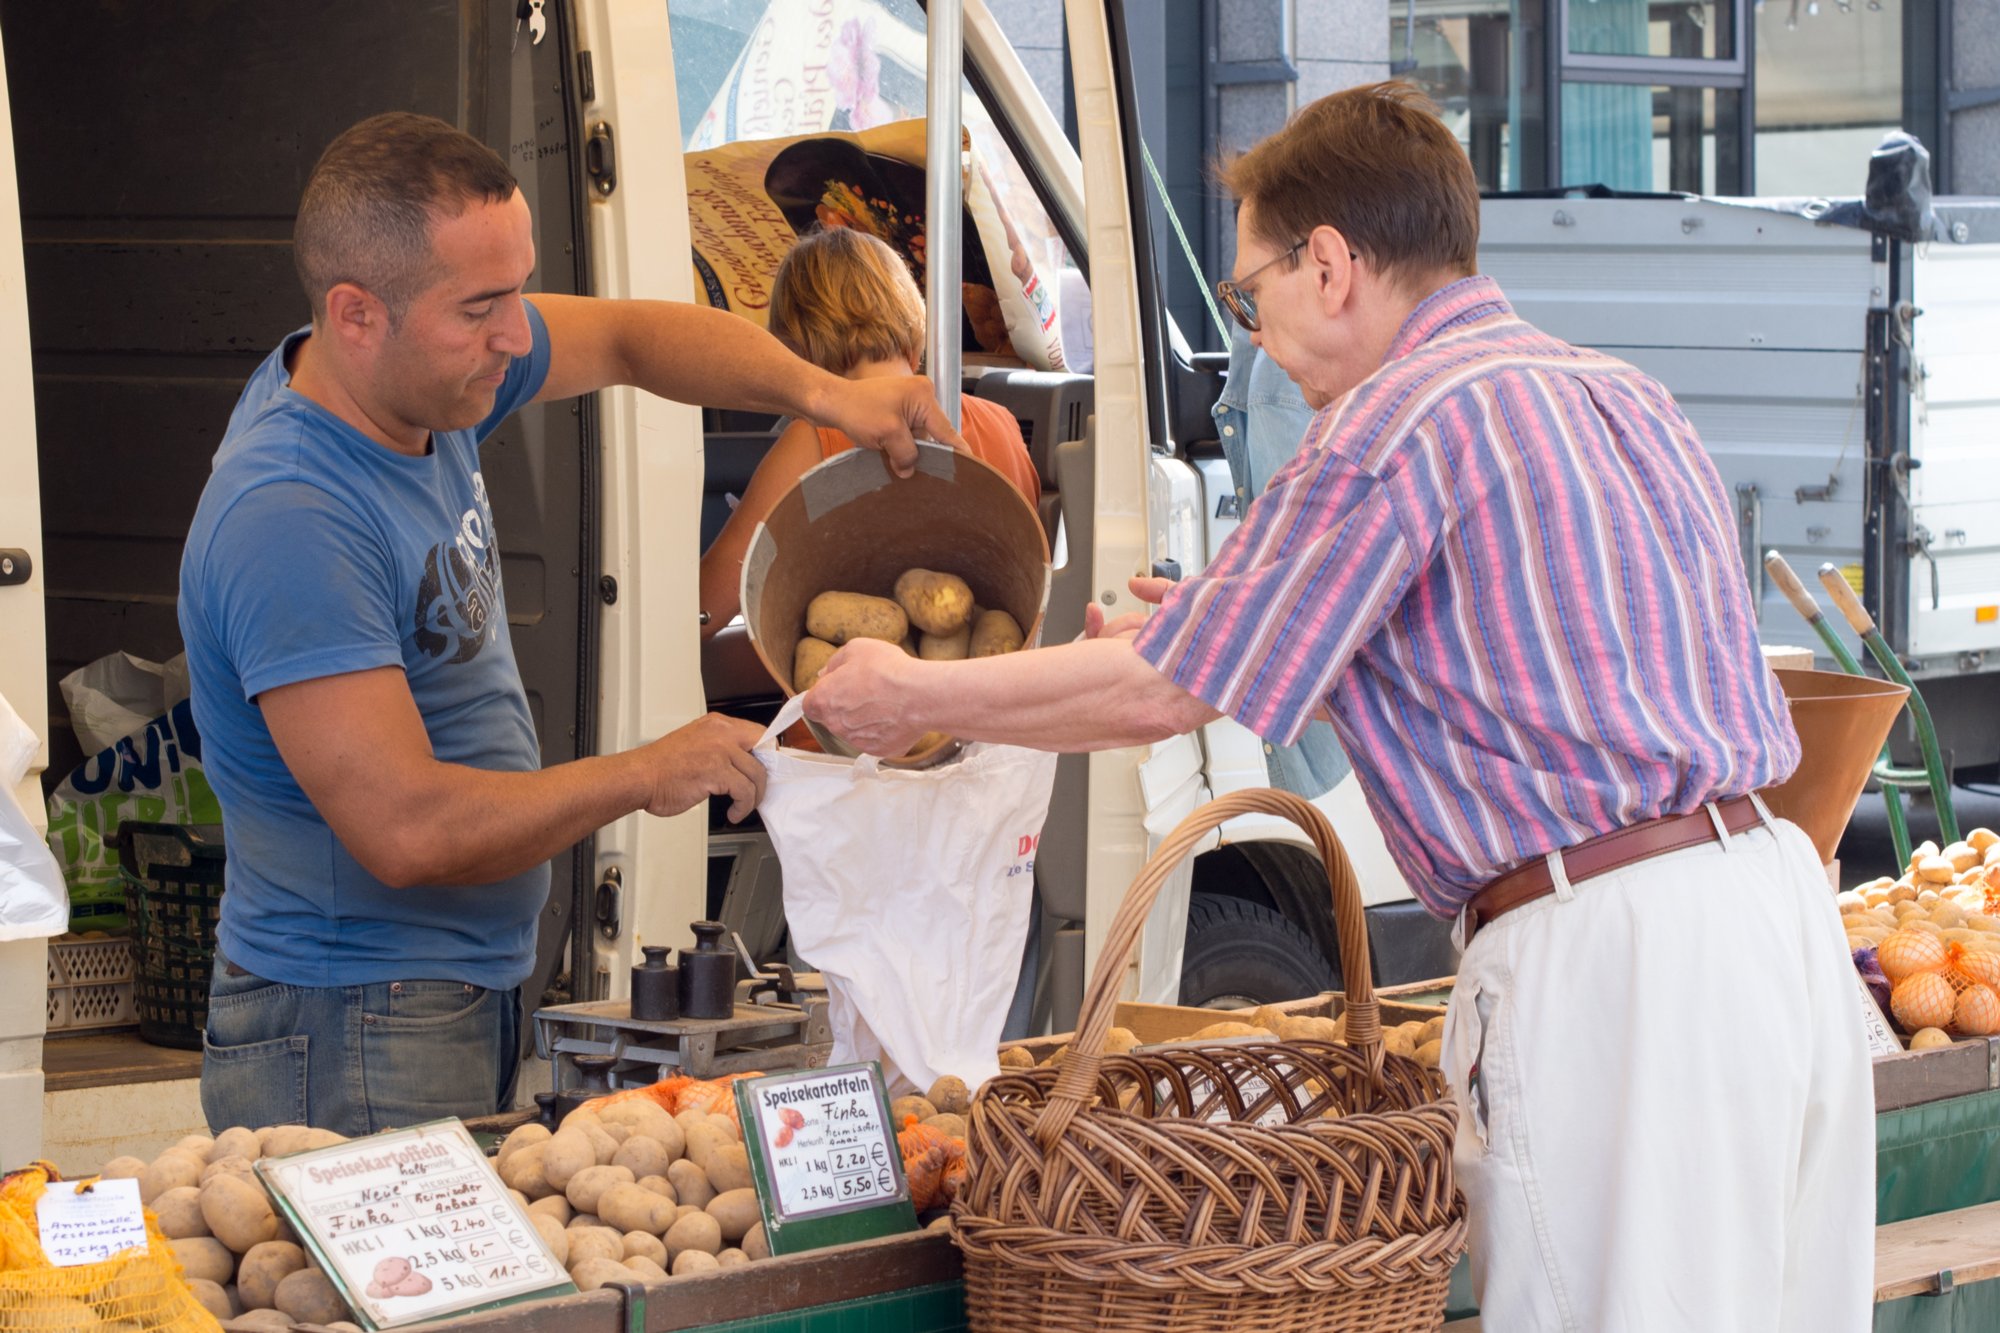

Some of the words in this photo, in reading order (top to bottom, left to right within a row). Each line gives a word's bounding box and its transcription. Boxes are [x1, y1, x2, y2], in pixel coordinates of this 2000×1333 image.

[763, 1076, 870, 1109] Speisekartoffeln
[821, 1099, 869, 1120] Finka
[307, 1142, 449, 1184] Speisekartoffeln
[806, 1161, 812, 1173] 1
[814, 1158, 828, 1173] kg
[871, 1142, 888, 1167] €
[801, 1186, 818, 1200] 2,5
[820, 1184, 834, 1199] kg
[843, 1175, 872, 1196] 5,50
[877, 1167, 894, 1193] €
[342, 1239, 375, 1256] HKL
[405, 1228, 417, 1241] 1
[419, 1224, 446, 1239] kg
[491, 1205, 513, 1225] €
[408, 1252, 438, 1270] 2,5
[439, 1248, 465, 1264] kg
[508, 1229, 530, 1249] €
[441, 1277, 455, 1291] 5
[454, 1273, 482, 1289] kg
[526, 1254, 547, 1273] €
